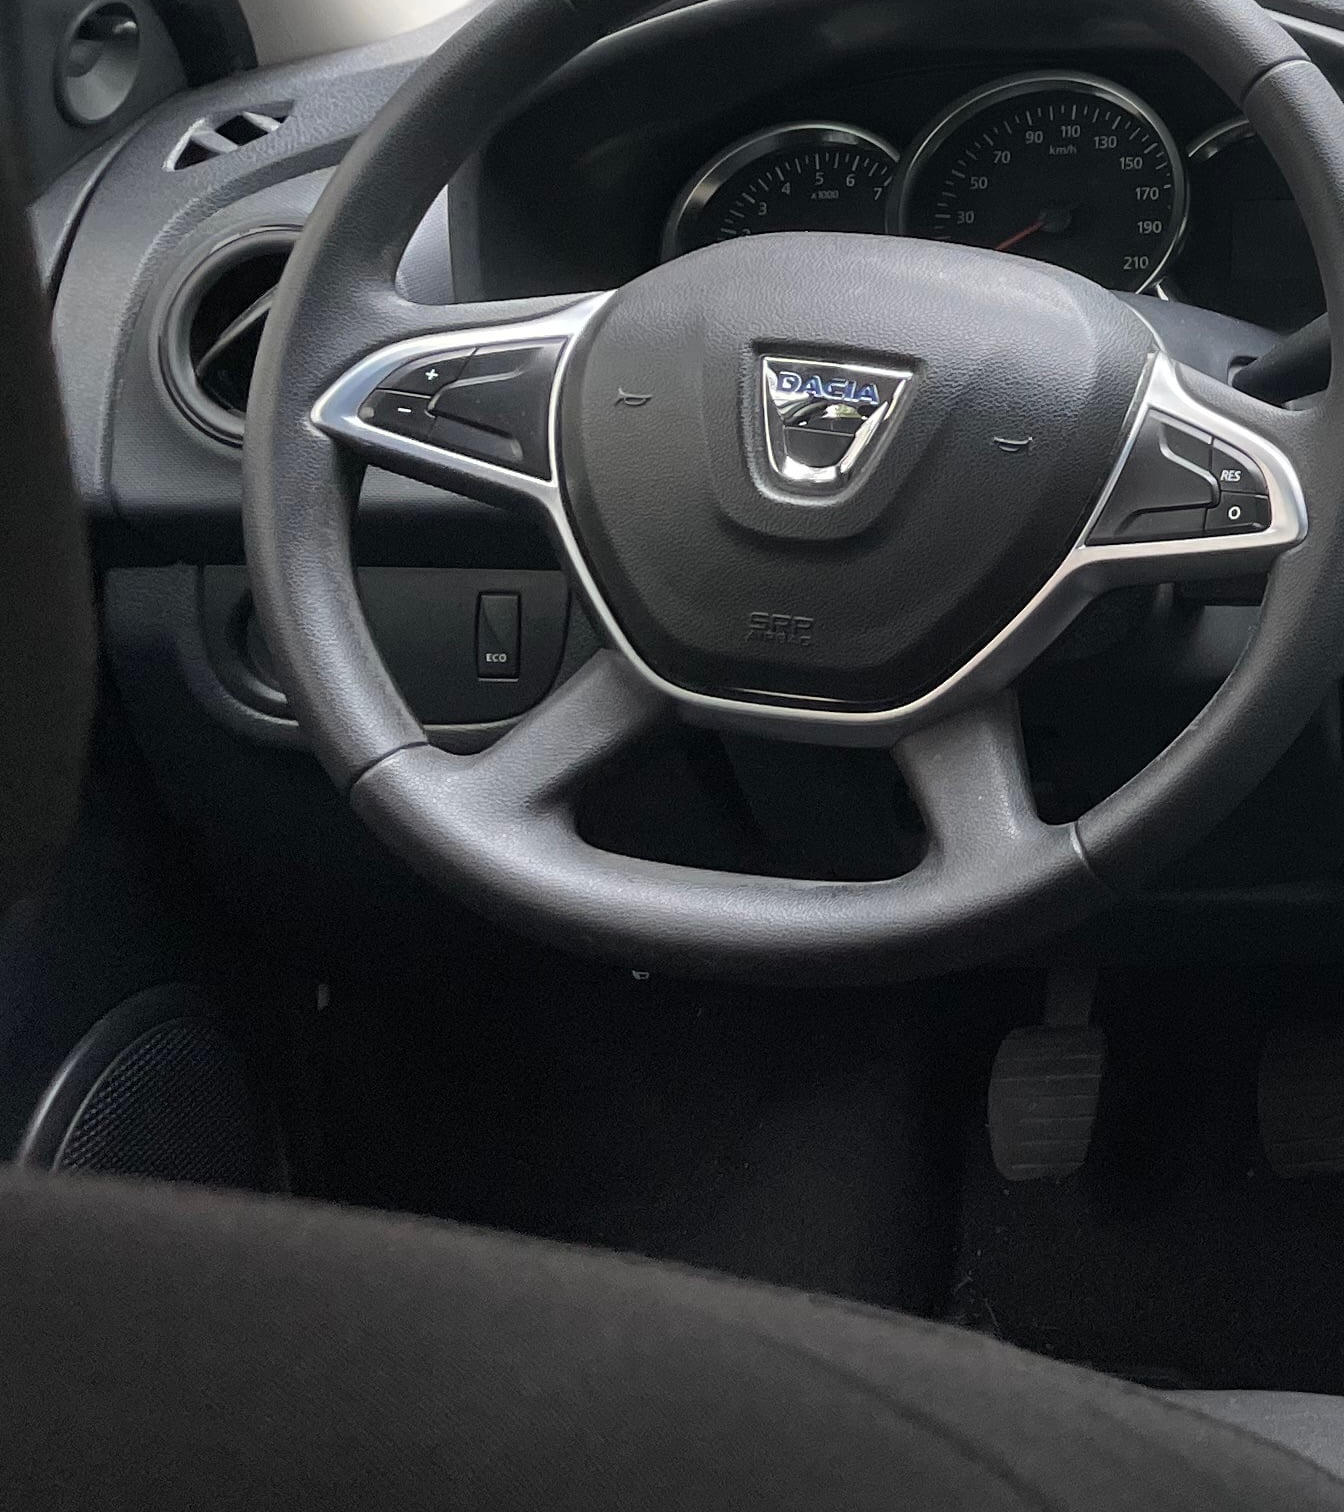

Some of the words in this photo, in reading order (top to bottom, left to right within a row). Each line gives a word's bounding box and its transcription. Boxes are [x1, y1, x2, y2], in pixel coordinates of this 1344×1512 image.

[1025, 130, 1044, 144] 90
[1061, 125, 1081, 138] 110
[1094, 136, 1117, 149] 130
[1049, 144, 1077, 155] km/h
[993, 150, 1011, 164] 70
[1120, 157, 1143, 170] 150
[815, 172, 824, 186] 5
[846, 174, 855, 187] 6
[970, 176, 988, 189] 50
[781, 182, 791, 195] 4
[873, 187, 883, 201] 7
[1136, 187, 1160, 200] 170
[758, 202, 767, 216] 3
[957, 210, 974, 224] 30
[1137, 221, 1163, 234] 190
[1123, 256, 1149, 270] 210
[775, 371, 880, 405] DACIA
[1220, 469, 1242, 482] RES
[485, 653, 508, 663] ECO
